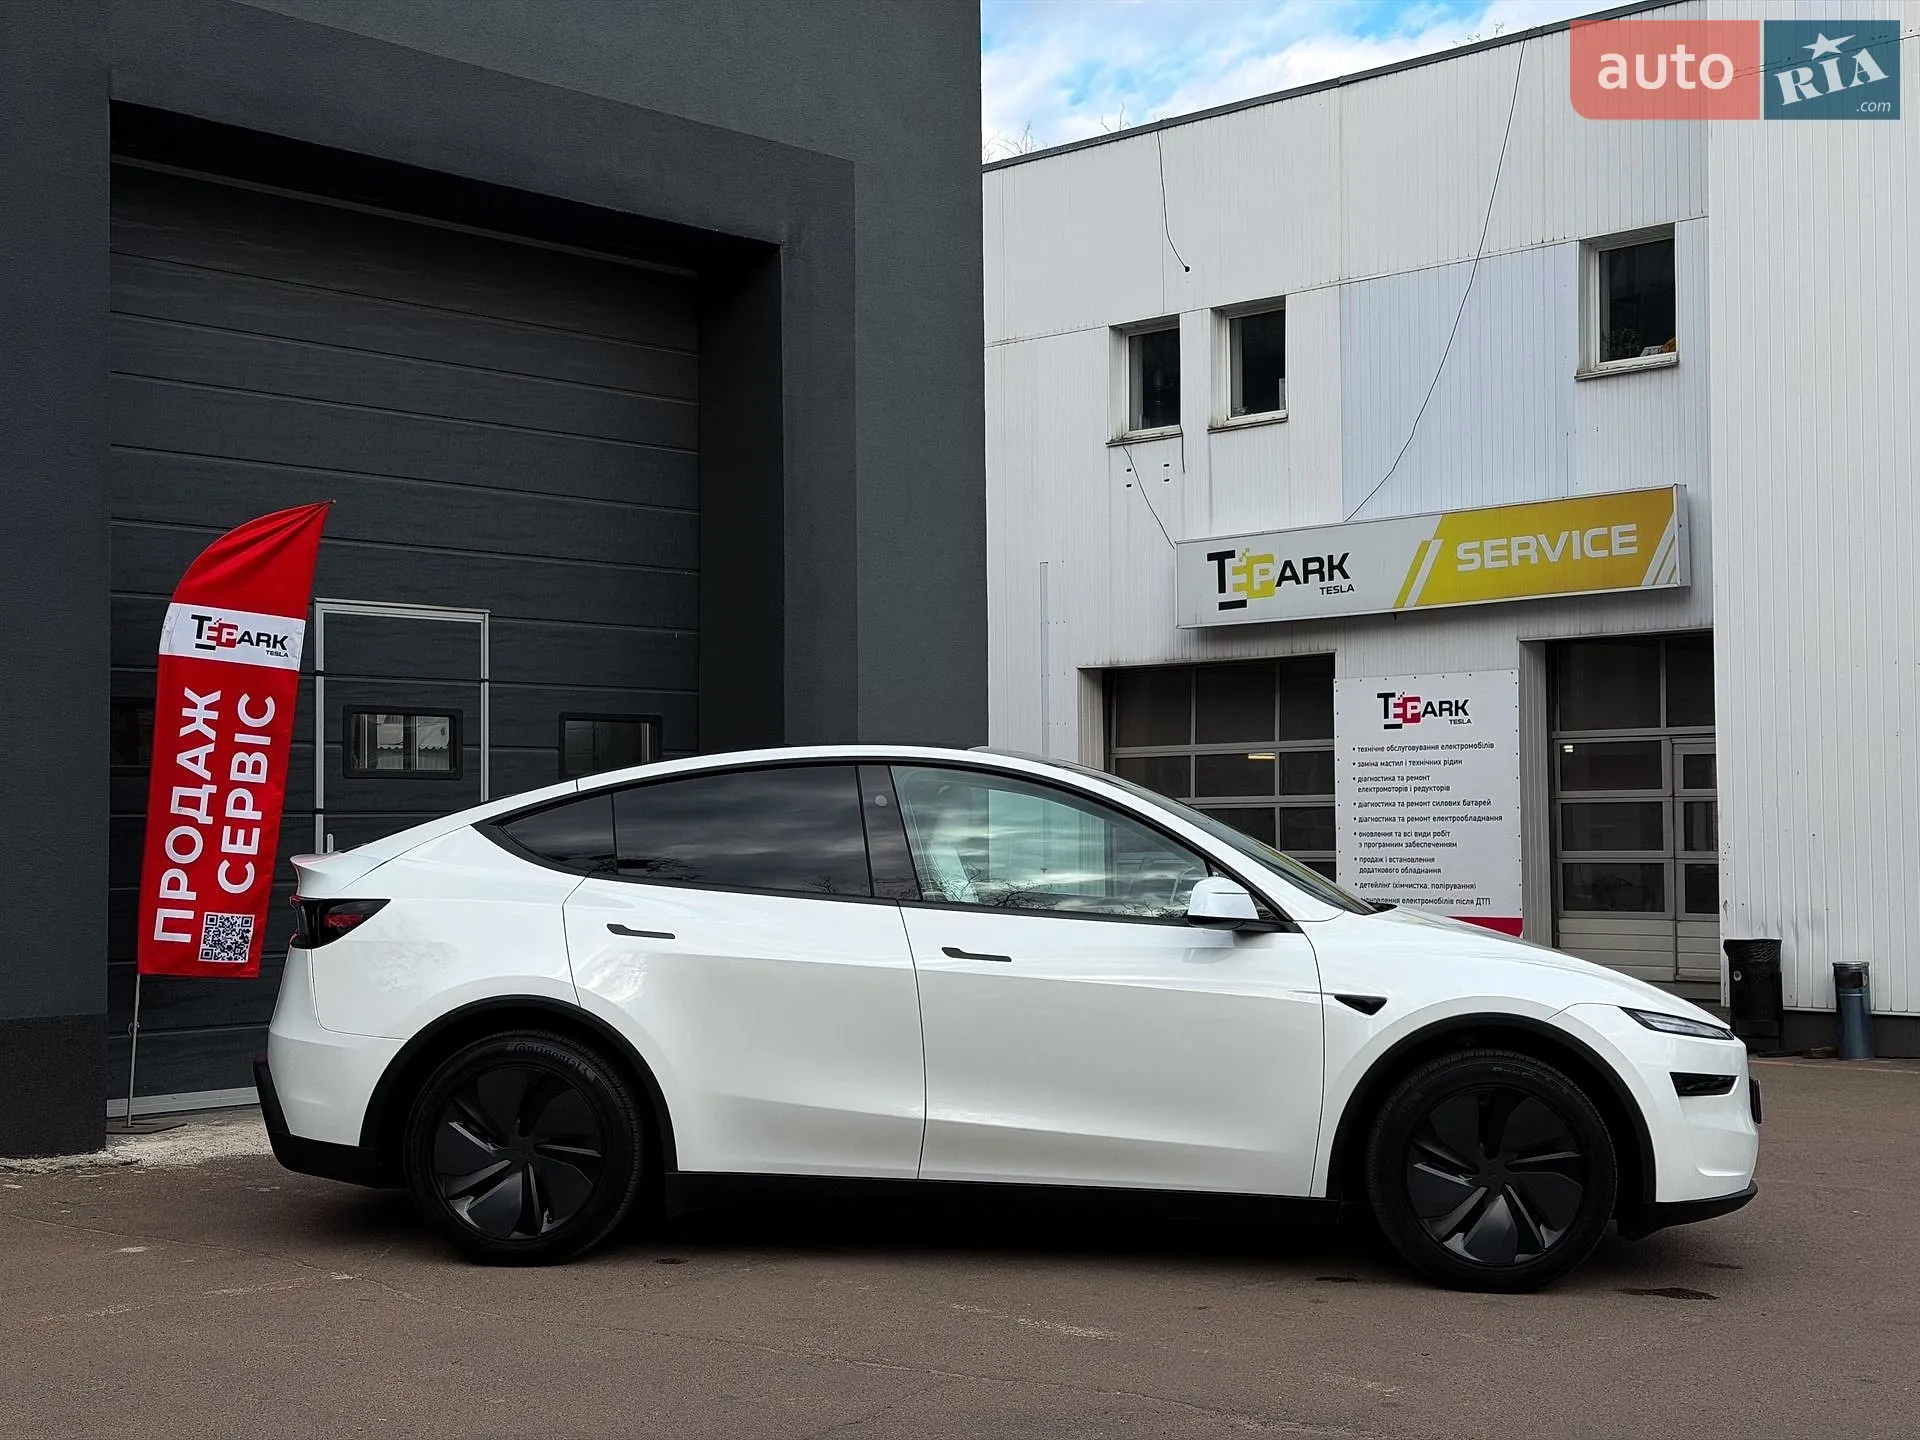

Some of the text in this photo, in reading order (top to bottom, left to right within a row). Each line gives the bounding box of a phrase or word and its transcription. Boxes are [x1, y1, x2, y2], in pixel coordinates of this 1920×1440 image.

[1456, 523, 1638, 572] SERVICE
[1320, 583, 1355, 595] TESLA
[266, 649, 289, 658] TESLA
[1357, 741, 1495, 753] технічне обслуговування електромобілів
[1357, 759, 1378, 767] заміна
[1380, 759, 1403, 767] мастил
[1408, 758, 1441, 766] технічних
[1443, 758, 1463, 767] рідин
[1357, 775, 1396, 783] діагностика
[1406, 775, 1431, 783] ремонт
[217, 693, 276, 893] СЕРВІС
[1357, 785, 1408, 794] електромоторів
[1413, 784, 1451, 794] редукторів
[1358, 800, 1396, 808] діагностика
[1406, 800, 1430, 809] ремонт
[1431, 799, 1461, 807] силових
[1462, 798, 1492, 808] батарей
[153, 687, 222, 943] ПРОДАЖ
[1358, 815, 1396, 823] діагностика
[1406, 815, 1431, 824] ремонт
[1432, 814, 1503, 823] електрообладнання
[1358, 830, 1393, 838] оновлення
[1403, 829, 1413, 837] всі
[1414, 830, 1431, 838] види
[1432, 829, 1451, 838] робіт
[1363, 841, 1403, 850] програмним
[1359, 856, 1384, 865] продаж
[1388, 856, 1435, 864] встановлення
[1400, 866, 1442, 875] обладнання
[1431, 881, 1477, 891] полірування)
[1401, 897, 1455, 906] електромобілів
[1475, 897, 1491, 906] ДТП
